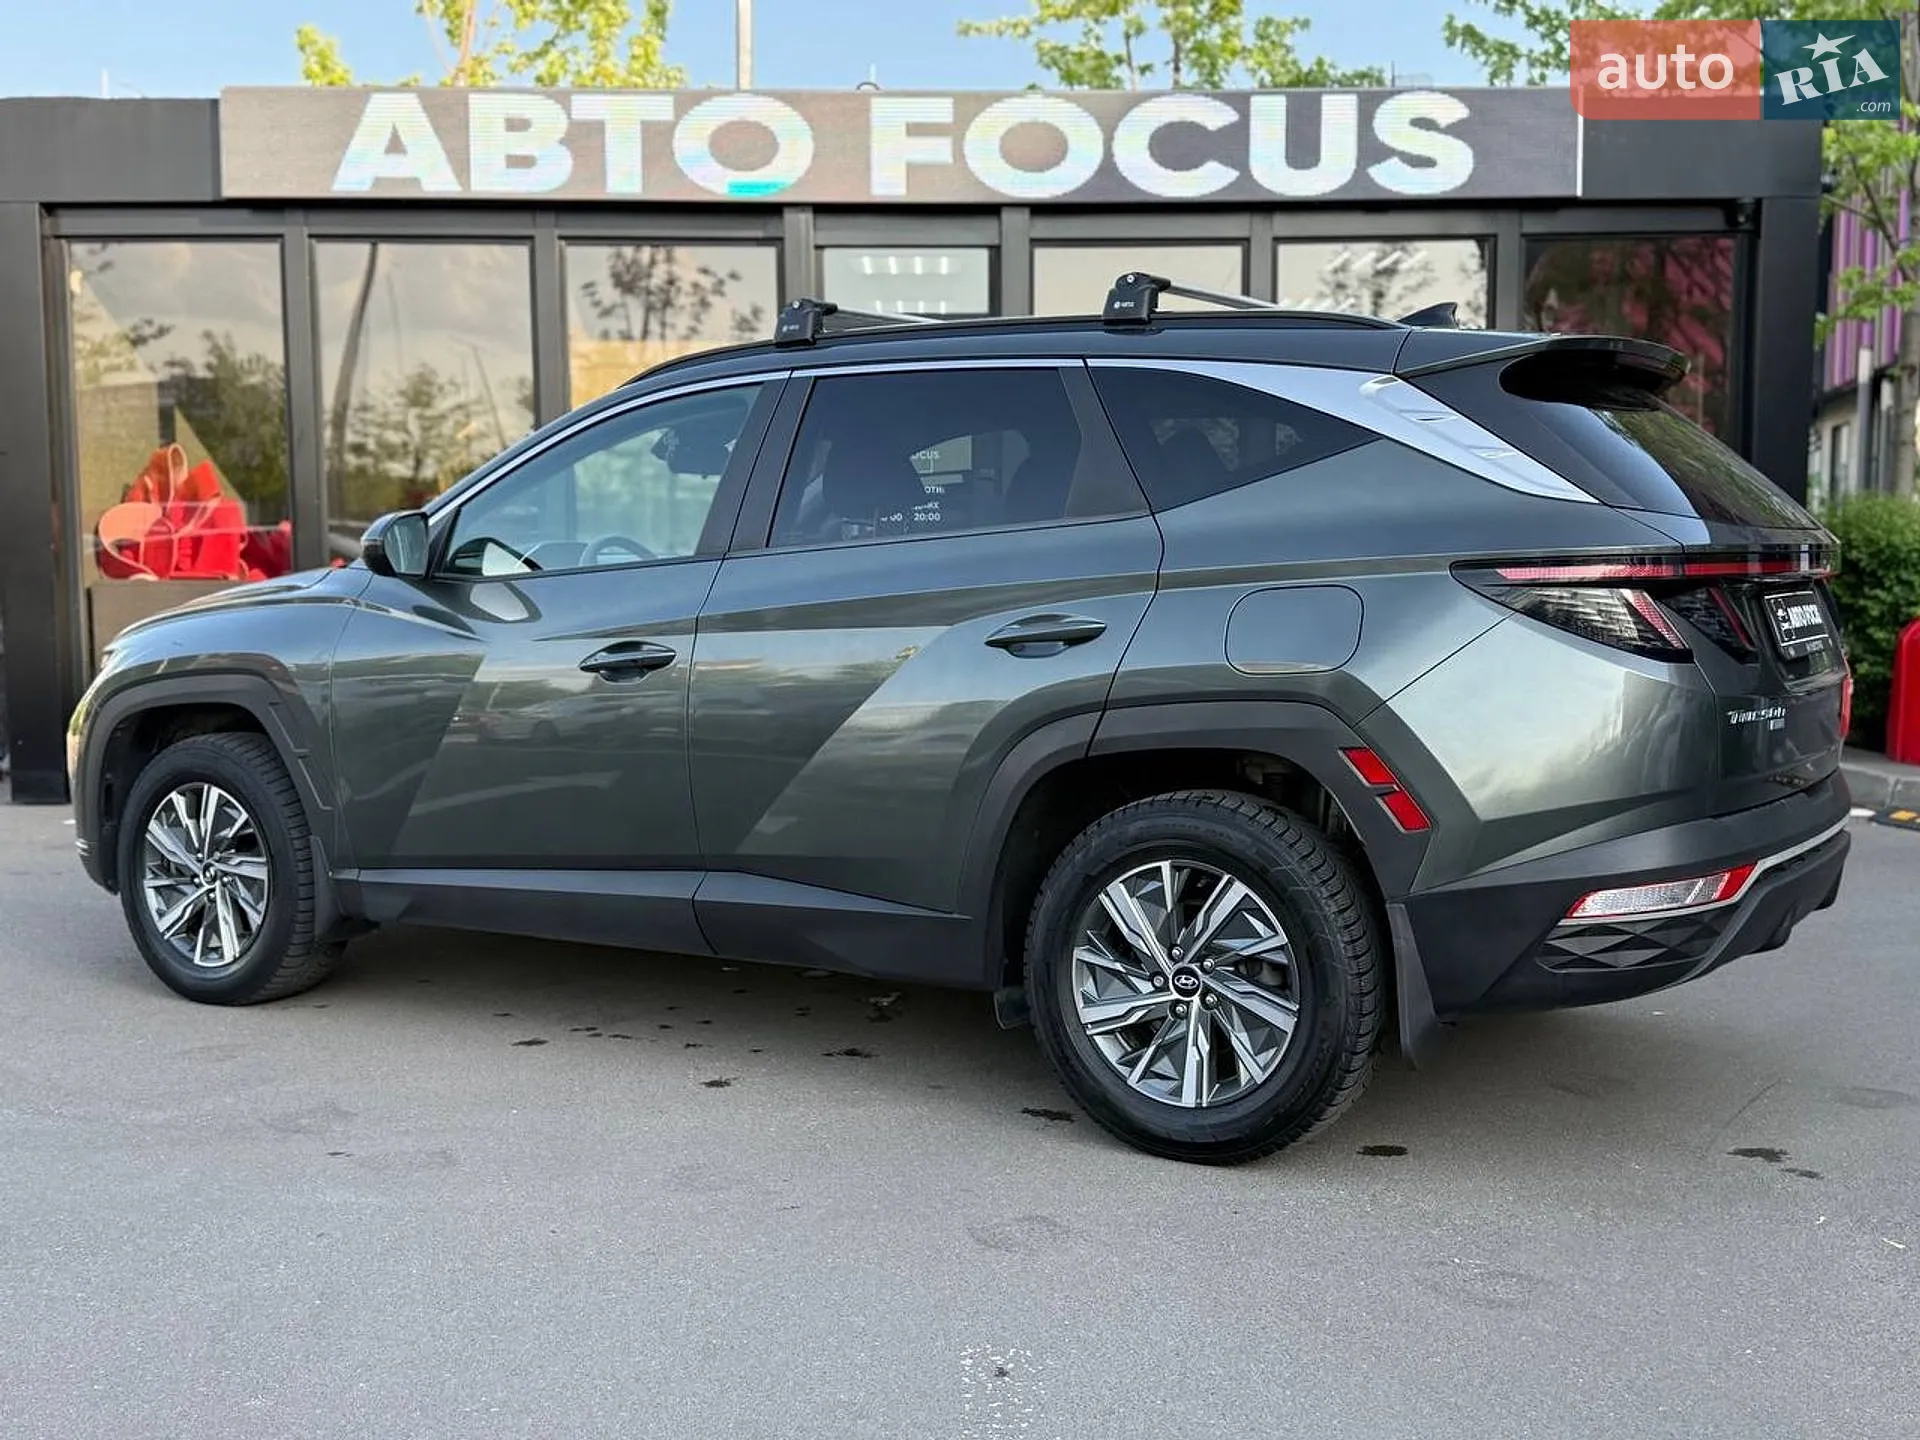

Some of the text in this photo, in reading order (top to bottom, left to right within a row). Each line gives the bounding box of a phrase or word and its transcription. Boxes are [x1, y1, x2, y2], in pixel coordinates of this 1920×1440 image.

[331, 90, 1475, 198] АВТО FOCUS
[913, 512, 941, 521] 20:00
